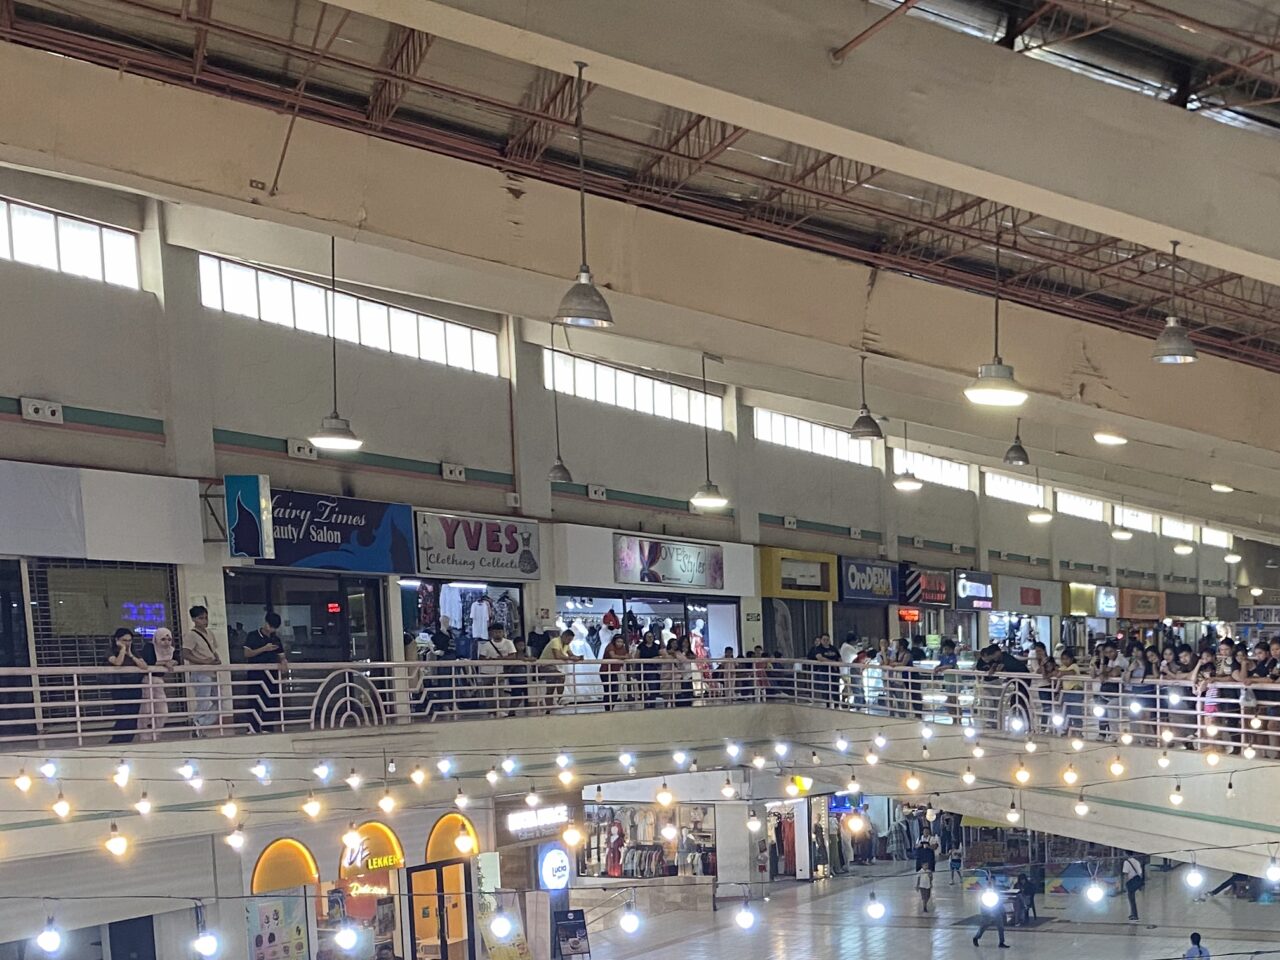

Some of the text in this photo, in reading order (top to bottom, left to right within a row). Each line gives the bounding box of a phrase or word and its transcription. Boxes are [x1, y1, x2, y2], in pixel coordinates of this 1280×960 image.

[314, 499, 366, 526] Times
[310, 524, 341, 544] Salon
[438, 517, 519, 554] YVES
[428, 553, 522, 570] Clothing Collecti
[680, 551, 706, 583] Styles
